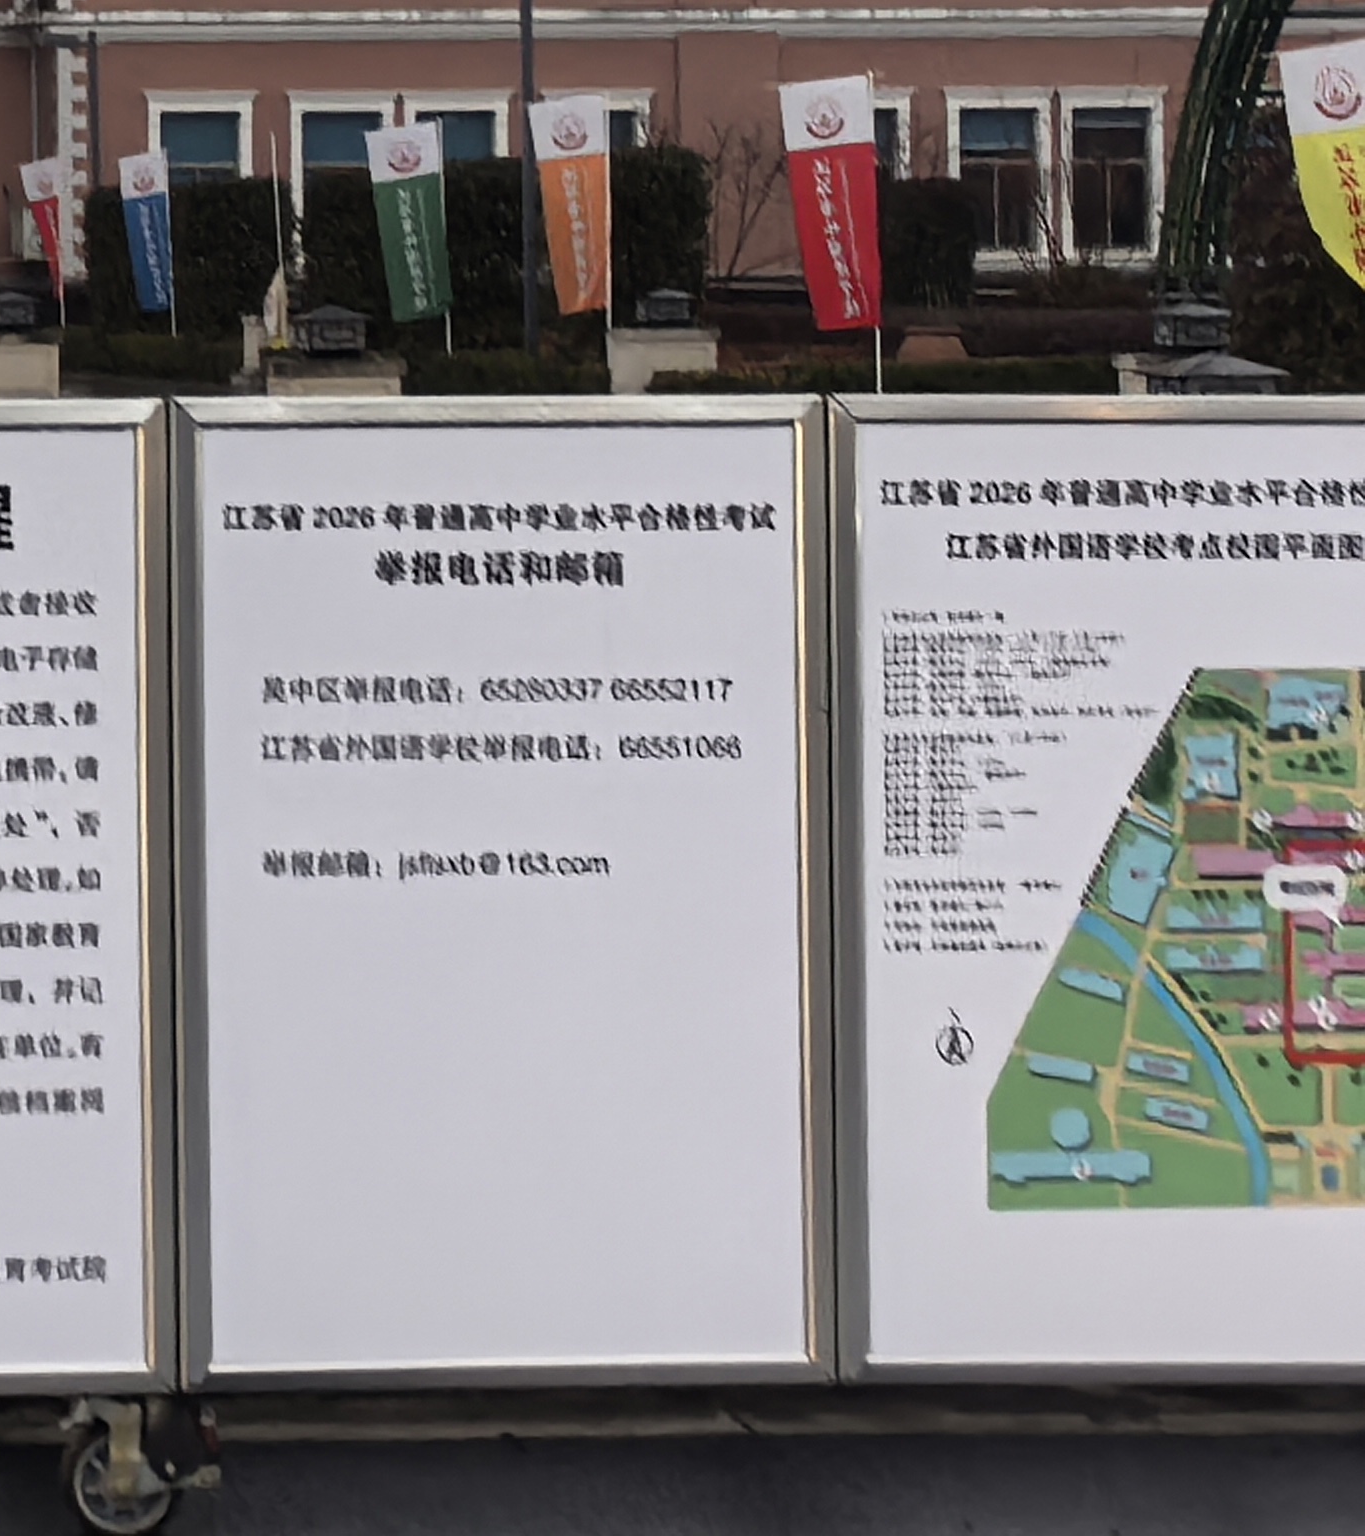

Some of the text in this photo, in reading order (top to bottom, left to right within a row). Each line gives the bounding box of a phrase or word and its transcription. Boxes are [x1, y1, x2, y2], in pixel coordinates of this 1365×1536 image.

[375, 550, 623, 587] 举报电话和邮箱
